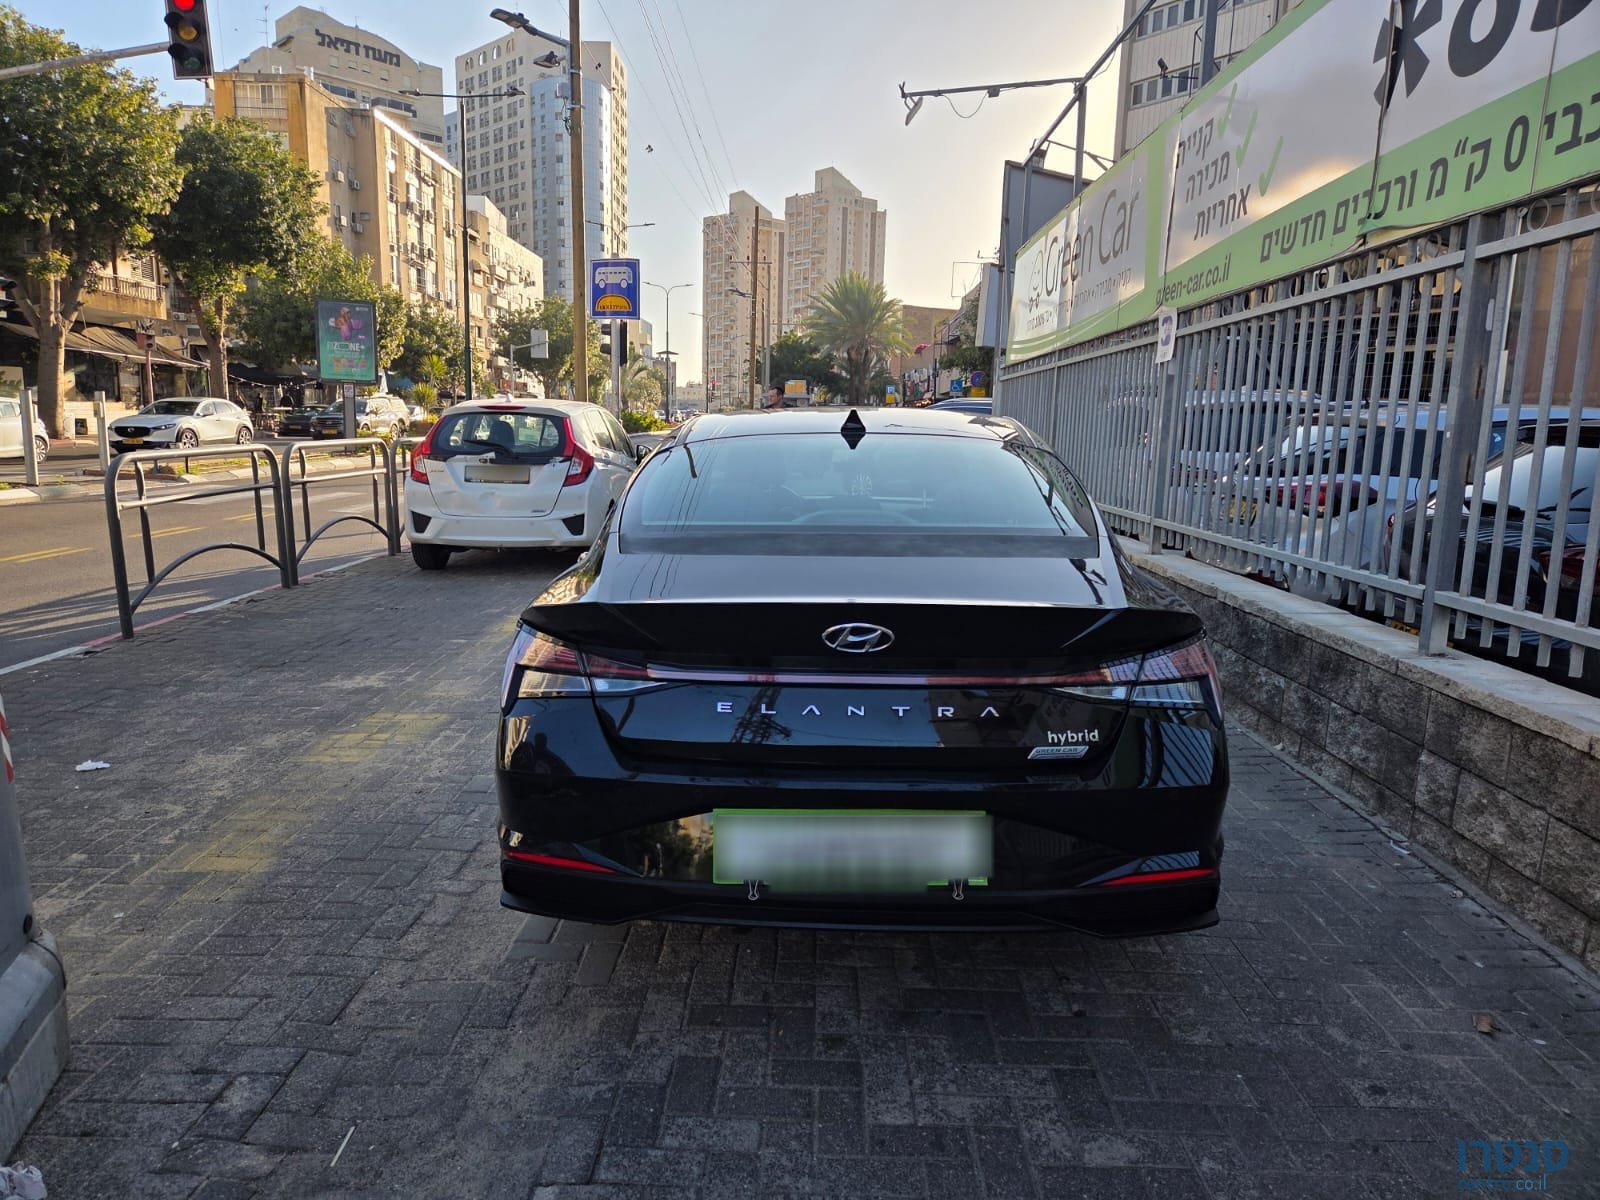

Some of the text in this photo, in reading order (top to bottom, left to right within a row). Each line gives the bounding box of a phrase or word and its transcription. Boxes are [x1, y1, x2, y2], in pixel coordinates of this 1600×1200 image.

[1176, 117, 1214, 169] קנייה
[1425, 136, 1493, 201] ק"מ
[1503, 115, 1530, 172] 0
[1185, 151, 1230, 203] מכירה
[1332, 169, 1418, 236] ורכבים
[1194, 183, 1251, 241] אחריות
[1260, 209, 1327, 263] חדשים
[1045, 188, 1140, 297] Green Car
[716, 702, 1000, 718] ELANTRA
[1047, 728, 1099, 746] hybrid
